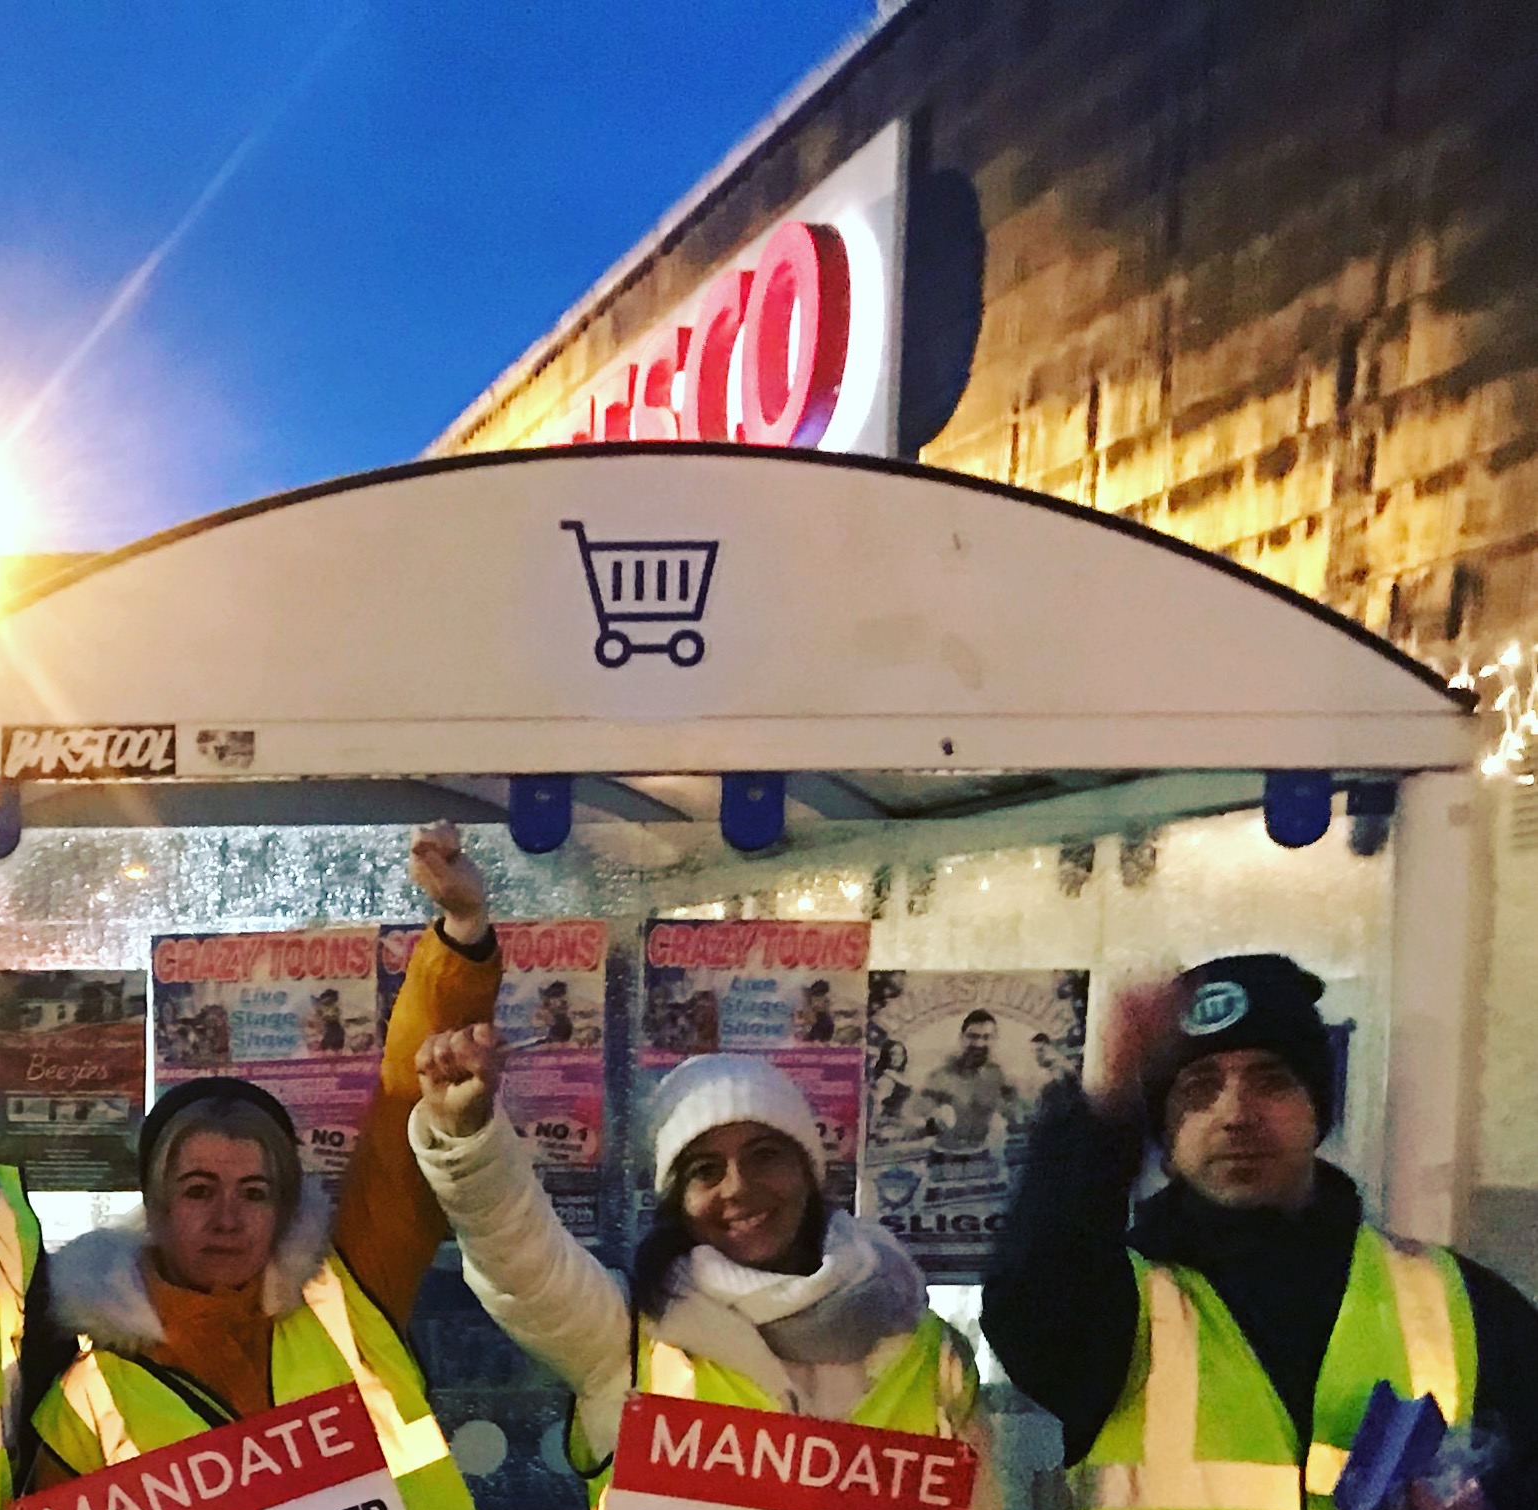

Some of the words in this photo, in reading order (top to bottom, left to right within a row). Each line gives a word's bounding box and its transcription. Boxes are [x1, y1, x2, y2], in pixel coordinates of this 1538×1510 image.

[3, 728, 176, 778] BARSTOOL
[153, 937, 260, 983] CRAZY
[264, 934, 374, 981] TOONS
[496, 927, 603, 971] TOONS
[647, 922, 759, 968] CRAZY
[757, 923, 868, 969] TOONS
[311, 1128, 345, 1147] NO
[535, 1122, 569, 1140] NO
[649, 1413, 956, 1508] MANDATE
